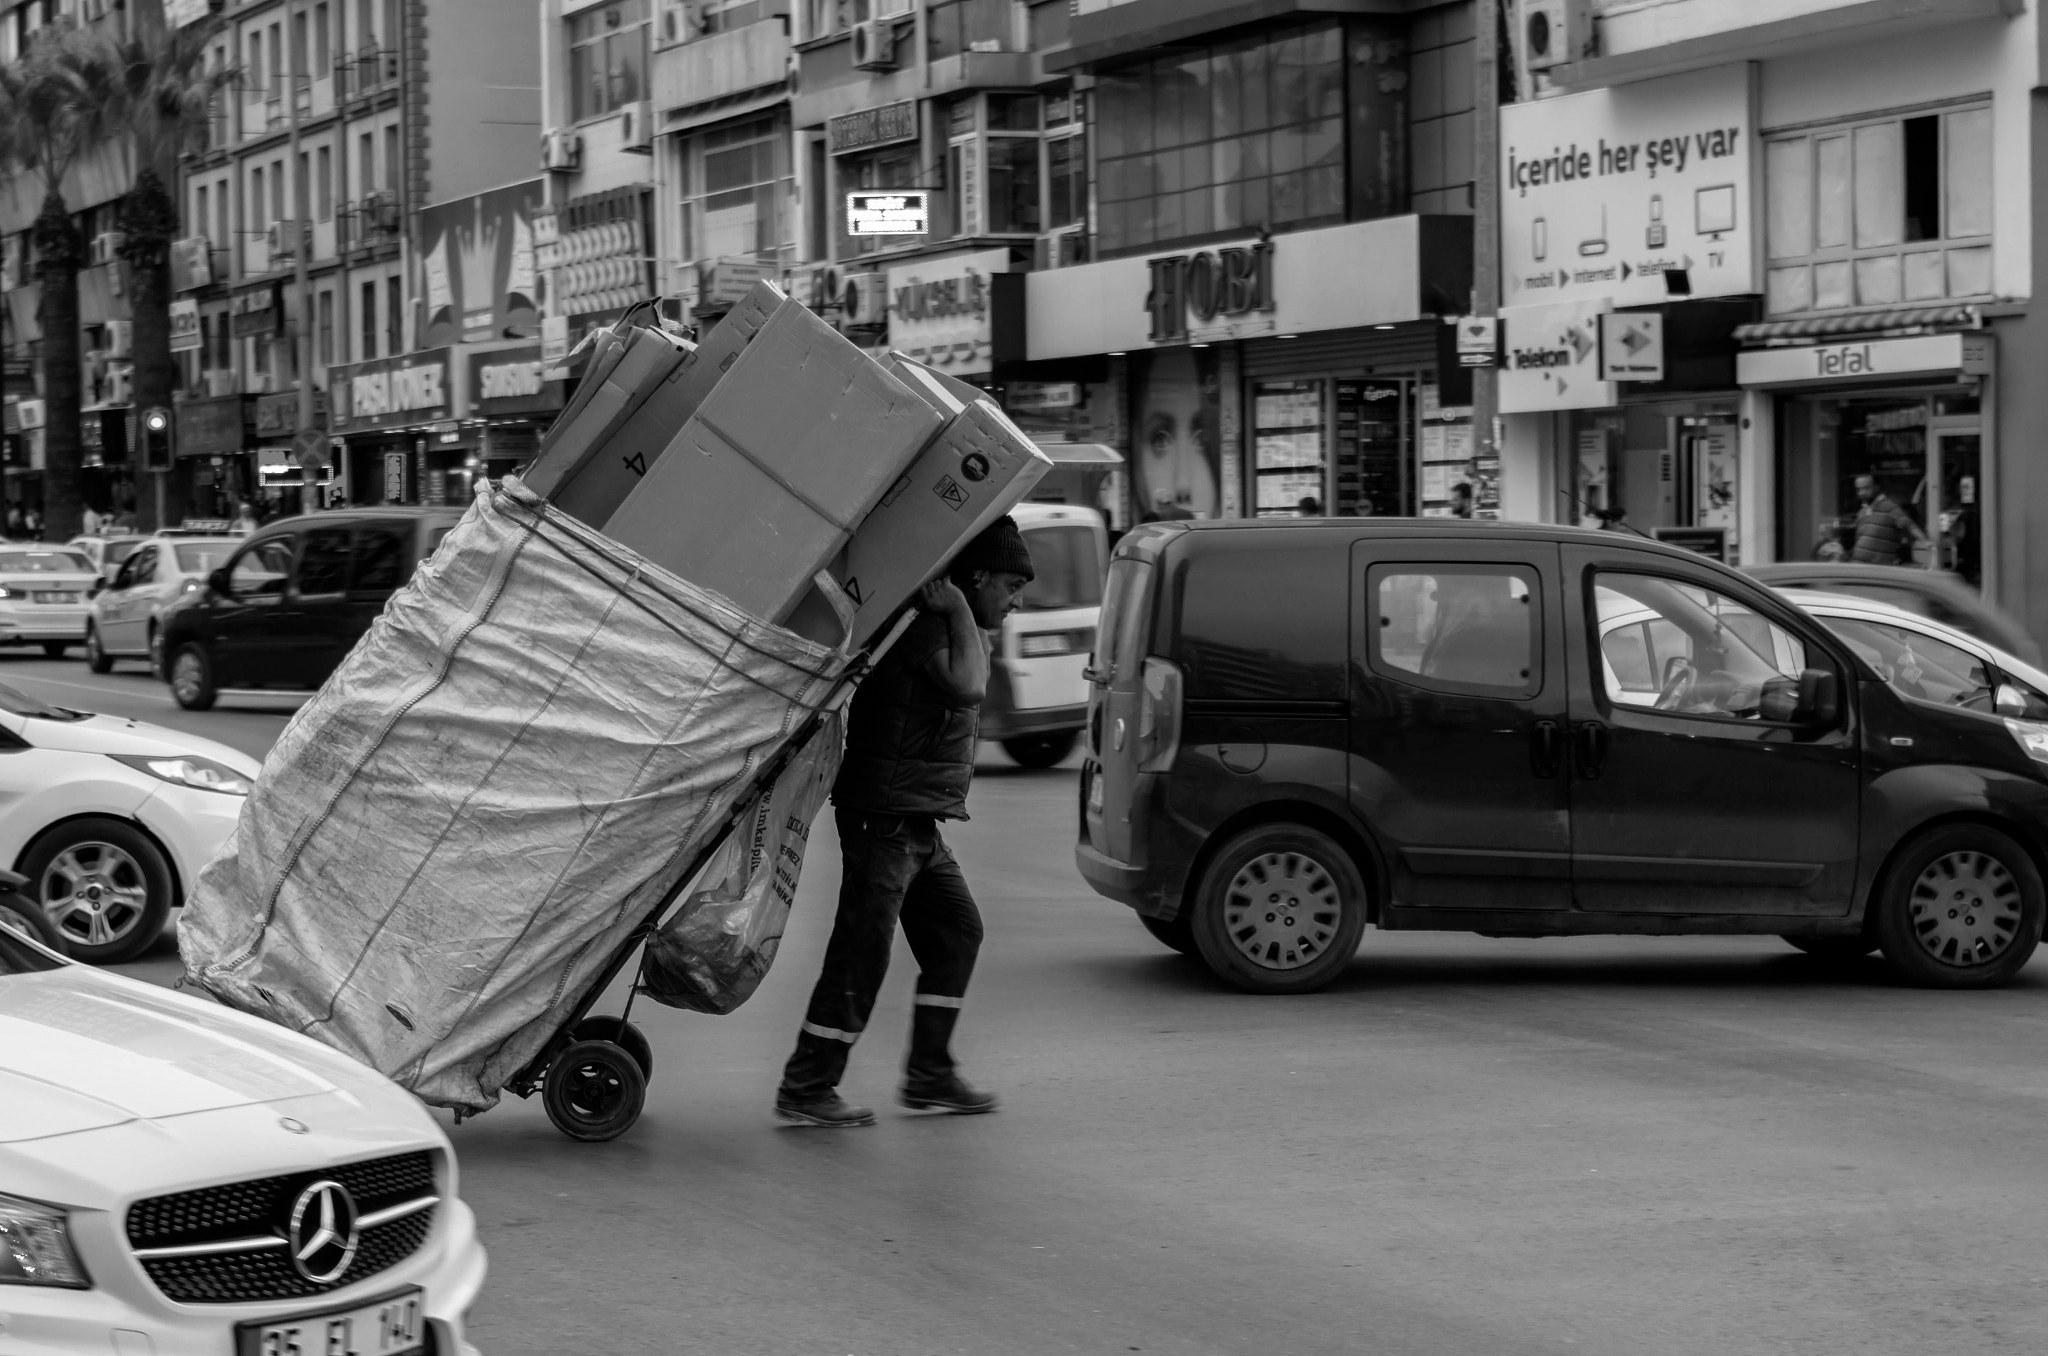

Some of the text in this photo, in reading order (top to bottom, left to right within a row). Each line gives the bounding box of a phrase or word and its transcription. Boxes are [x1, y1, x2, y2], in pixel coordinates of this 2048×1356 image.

[1508, 126, 1740, 198] İçeride her şey var
[1708, 251, 1725, 269] TV
[1525, 272, 1556, 289] mobil
[1573, 265, 1616, 284] internet
[1512, 346, 1571, 370] Telekom
[1813, 344, 1875, 377] Tefal
